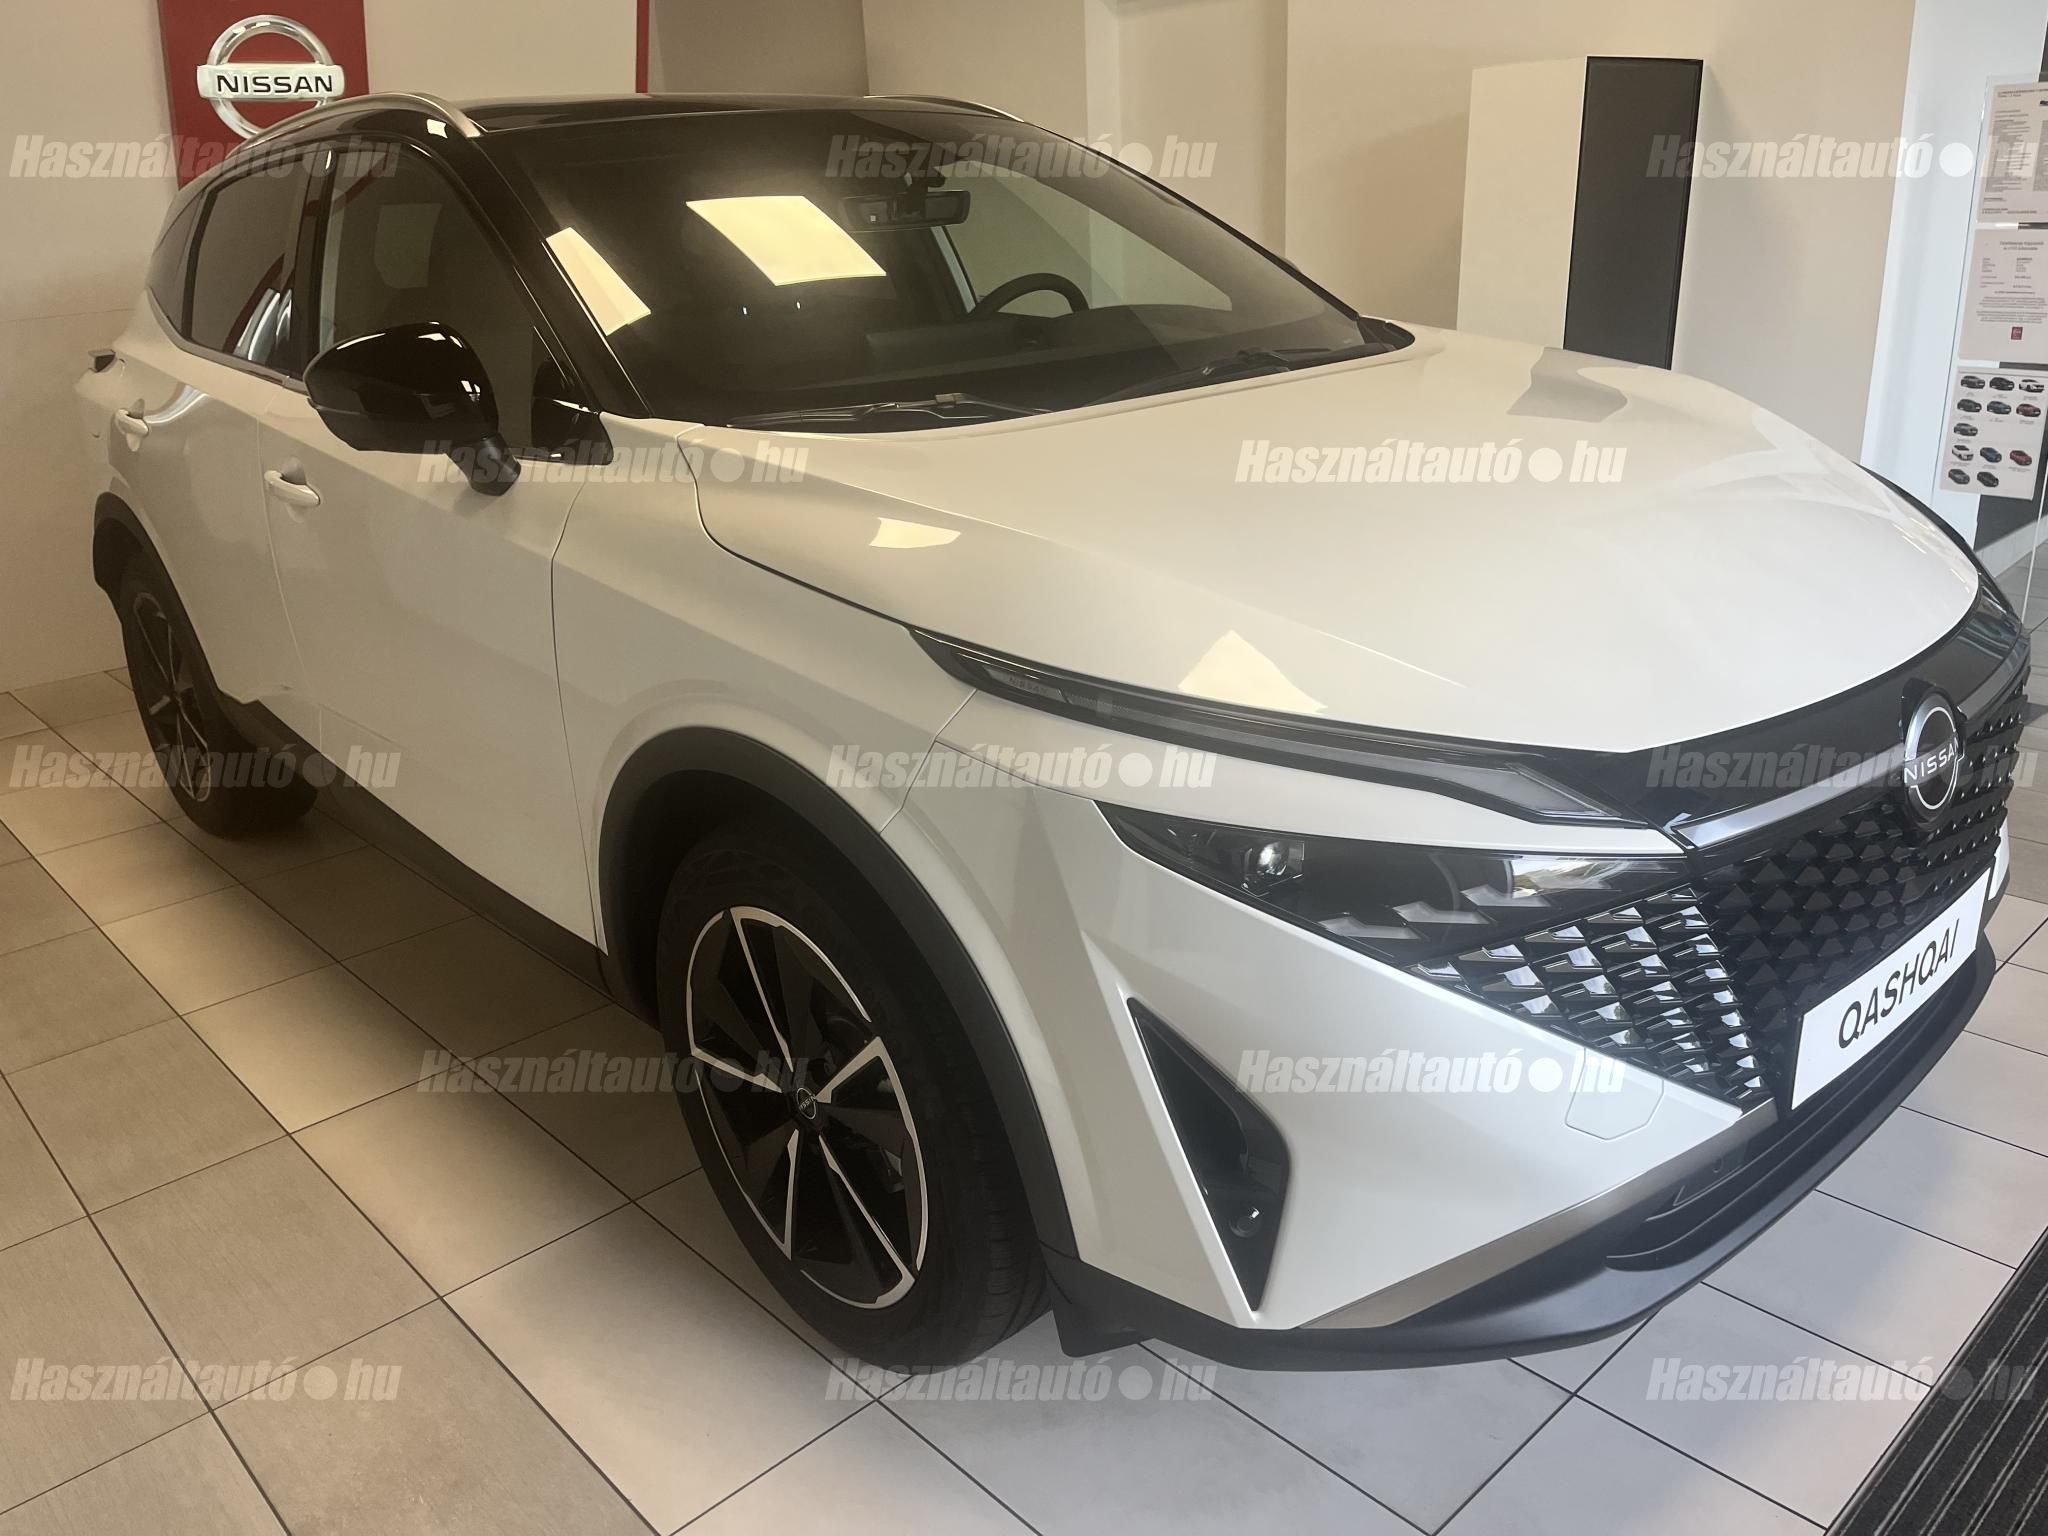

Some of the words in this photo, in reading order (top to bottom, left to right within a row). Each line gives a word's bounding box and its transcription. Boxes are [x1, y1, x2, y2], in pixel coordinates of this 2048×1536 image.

[217, 75, 333, 93] NISSAN
[1904, 736, 1959, 784] NISSAN
[1838, 918, 1960, 1049] QASHQAI
